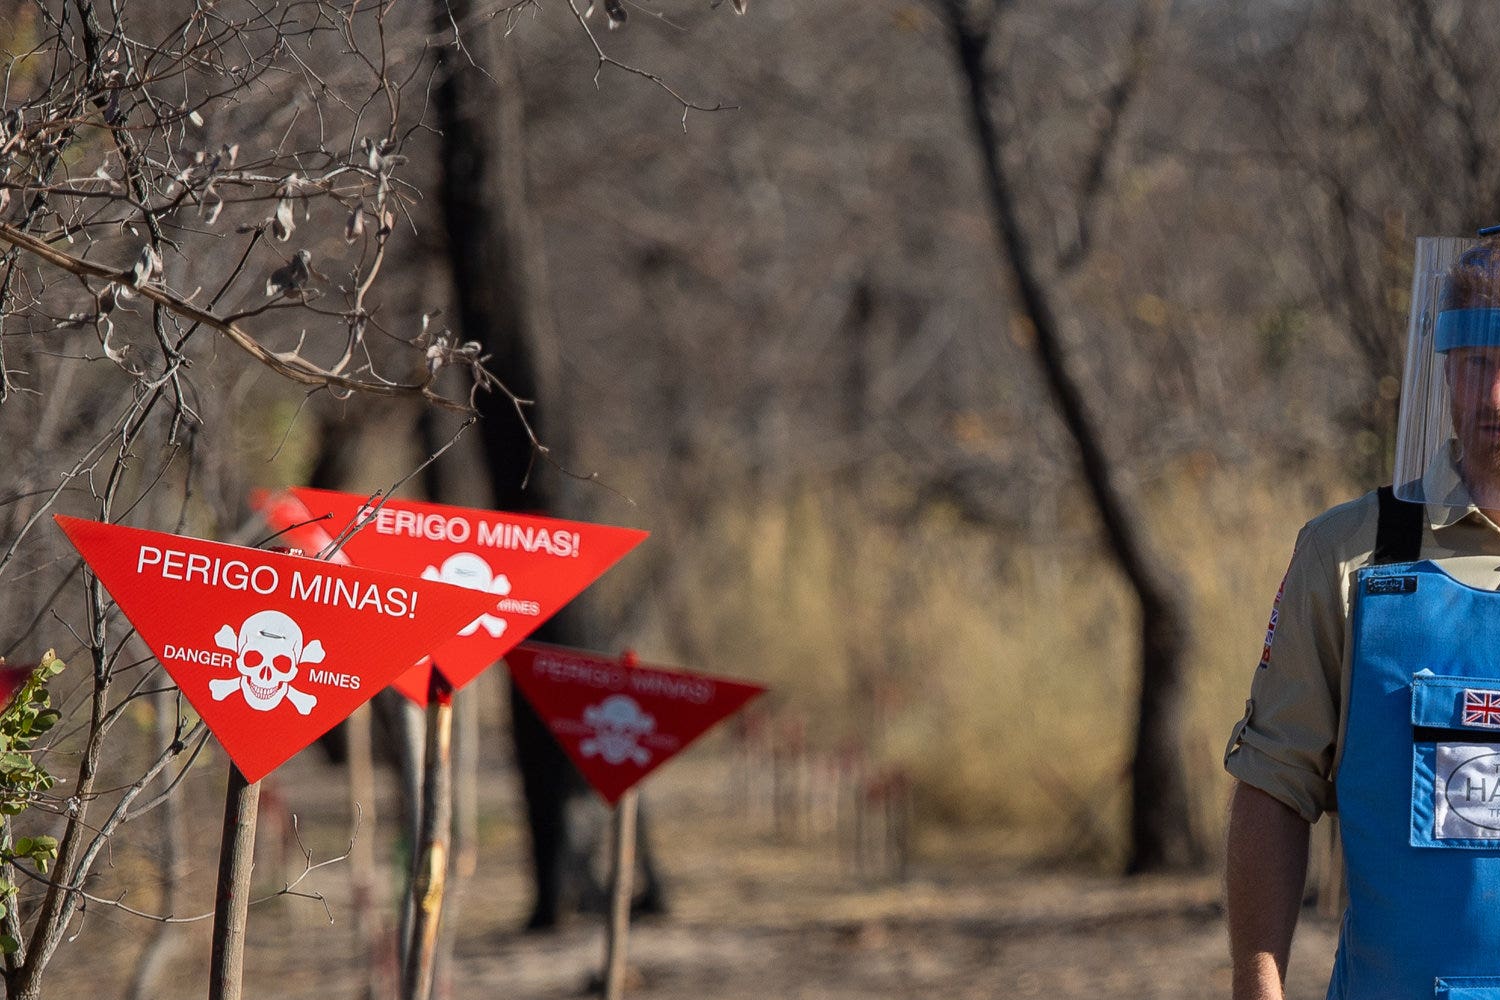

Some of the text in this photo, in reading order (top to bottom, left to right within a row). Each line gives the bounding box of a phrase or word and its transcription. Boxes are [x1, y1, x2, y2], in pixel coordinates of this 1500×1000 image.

[356, 505, 581, 558] PERIGO MINAS!
[136, 545, 418, 619] PERIGO MINAS!
[163, 644, 361, 690] DANGER MINES
